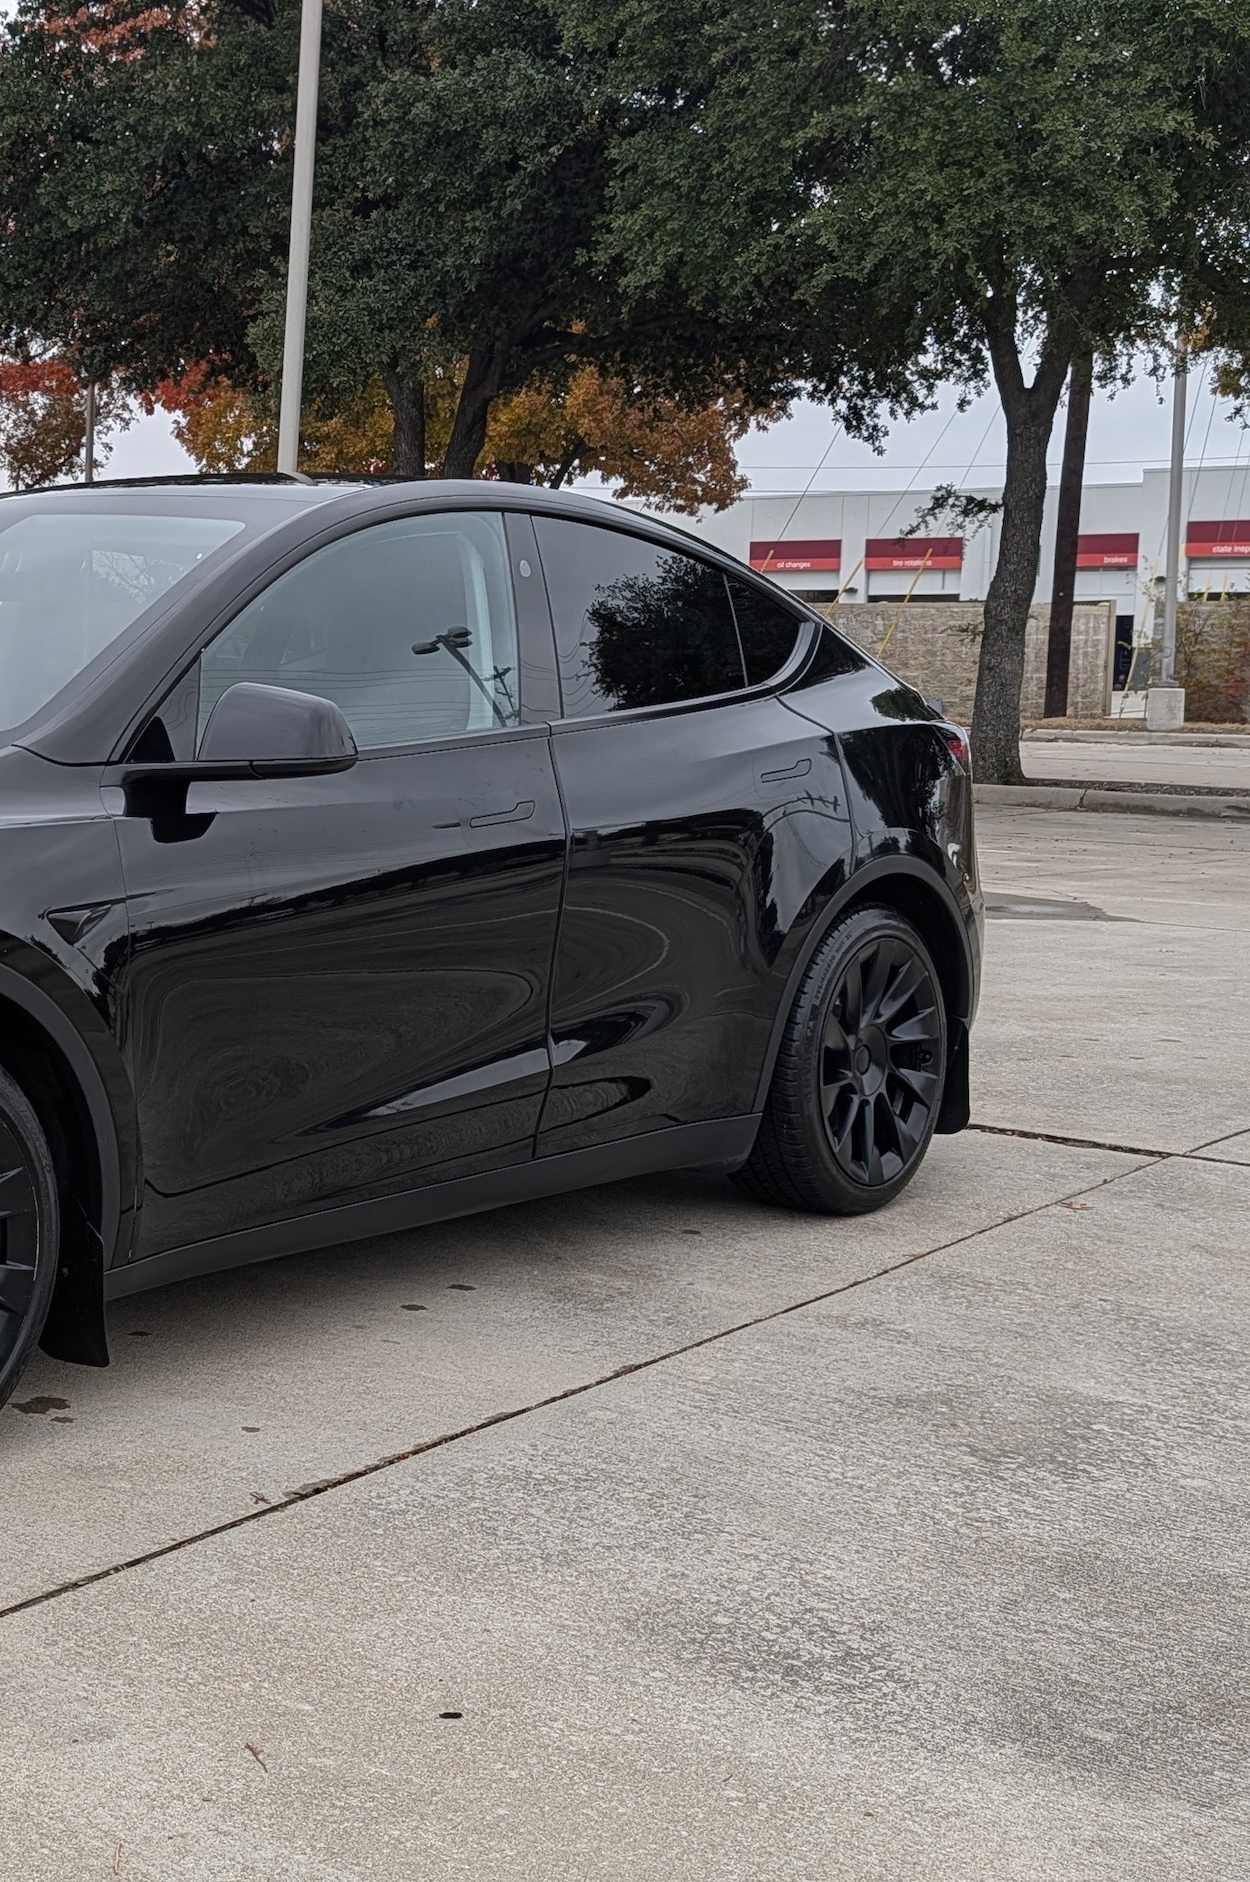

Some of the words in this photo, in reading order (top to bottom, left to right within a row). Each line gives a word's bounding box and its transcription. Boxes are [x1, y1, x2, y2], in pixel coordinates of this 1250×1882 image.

[1212, 545, 1232, 553] state
[904, 559, 932, 567] rotatios
[1103, 555, 1128, 564] brakes
[776, 561, 784, 569] oil
[785, 561, 811, 570] changes
